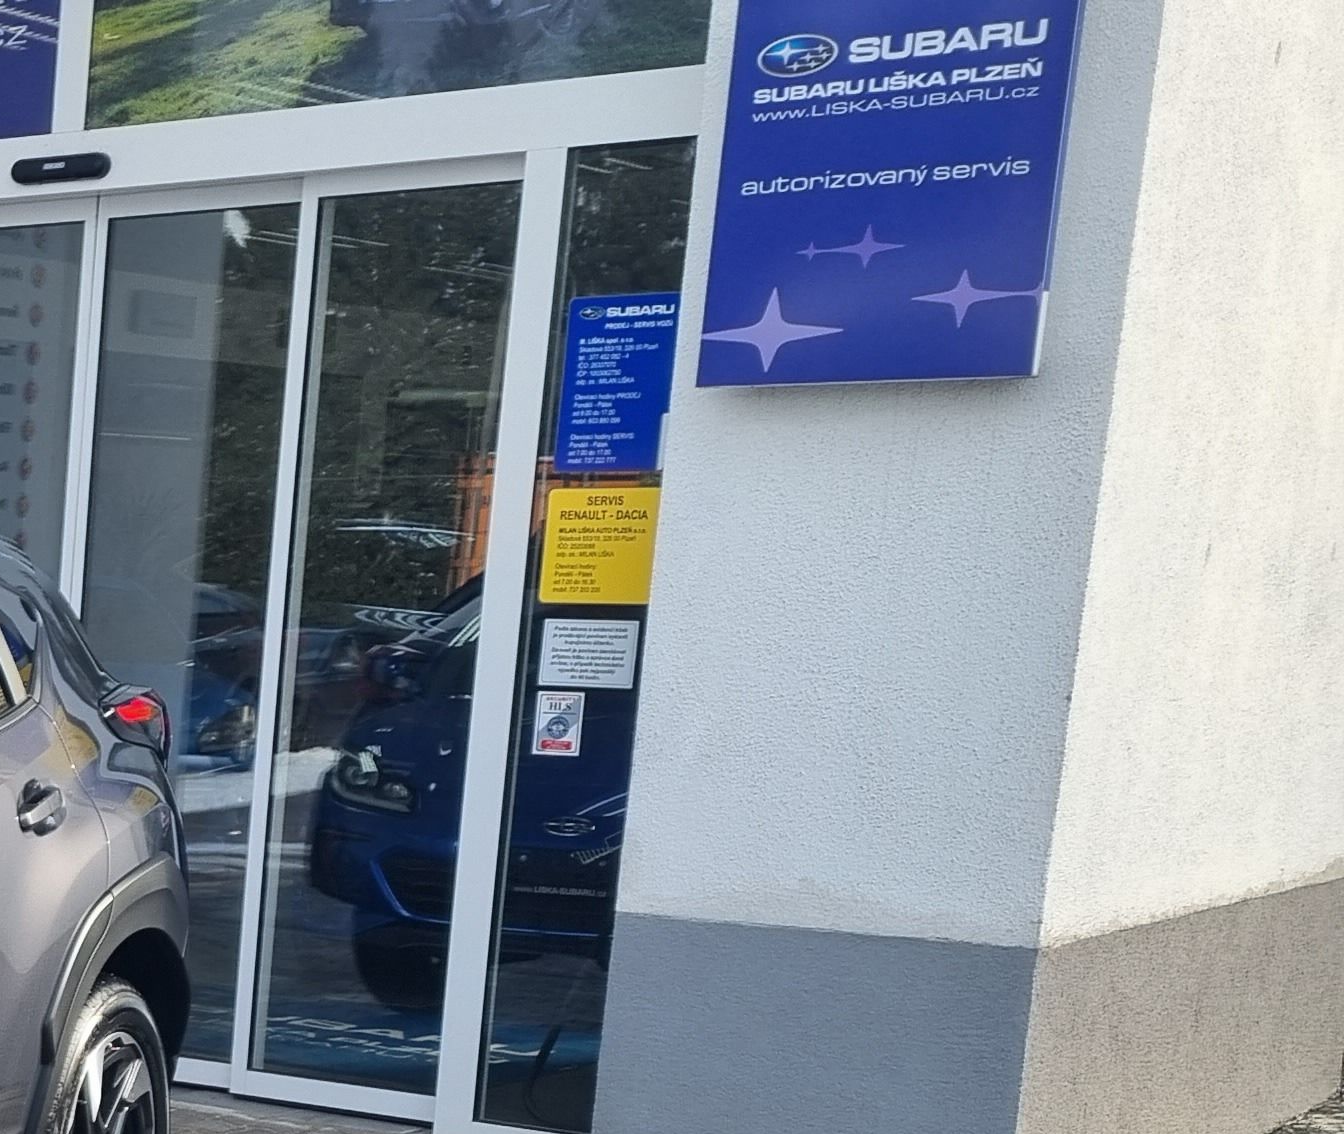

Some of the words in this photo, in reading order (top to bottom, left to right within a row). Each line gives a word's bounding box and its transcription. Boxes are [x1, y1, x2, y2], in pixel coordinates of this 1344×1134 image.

[848, 18, 1050, 64] SUBARU
[753, 78, 864, 105] SUBARU
[868, 70, 947, 94] LIŠKA
[951, 57, 1044, 86] PLZEŇ
[752, 85, 1041, 123] www.LISKA-SUBARU.cz
[741, 164, 928, 197] autorizovaný
[932, 156, 1031, 182] servis
[606, 304, 675, 318] SUBARU
[560, 510, 607, 521] RENAULT
[616, 509, 648, 520] DACIA
[587, 495, 624, 506] SERVIS
